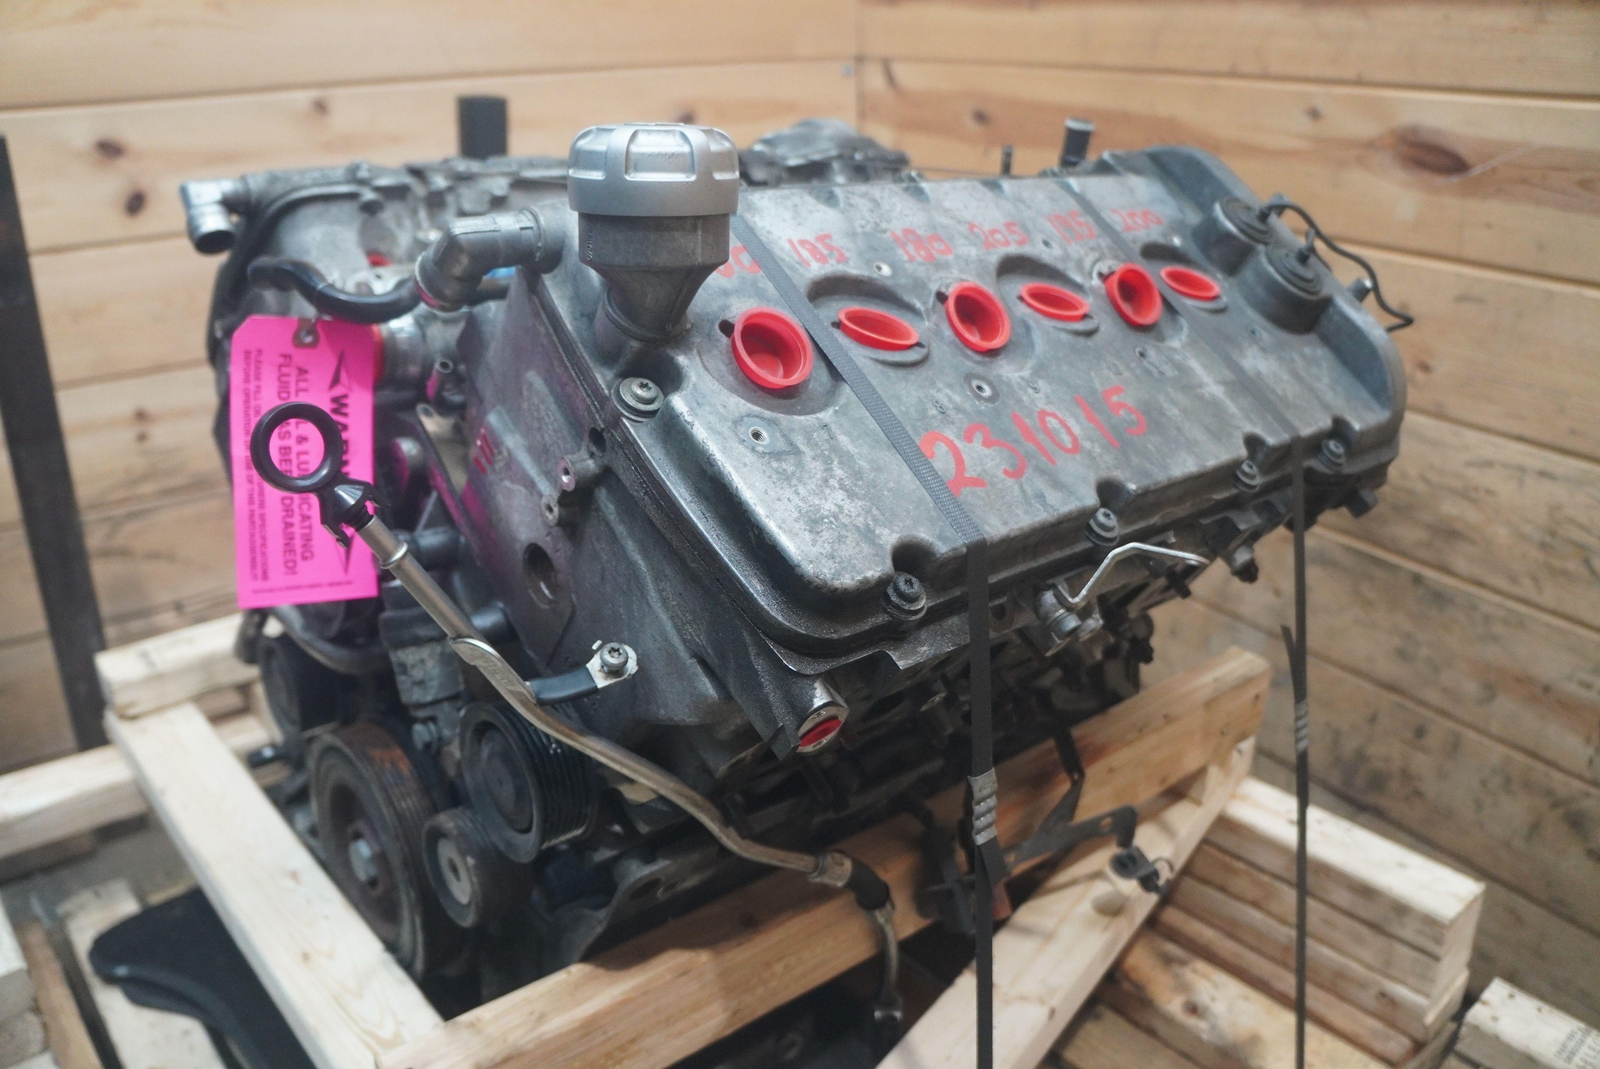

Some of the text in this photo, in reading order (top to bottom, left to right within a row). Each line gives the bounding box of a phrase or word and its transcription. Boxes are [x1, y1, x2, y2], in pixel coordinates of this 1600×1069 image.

[787, 233, 847, 268] 185
[890, 227, 954, 263] 180
[968, 221, 1029, 250] 205
[277, 354, 292, 401] FLUID
[296, 366, 309, 397] ALL
[933, 399, 947, 414] 8
[295, 435, 309, 445] &
[919, 384, 1148, 498] 231015
[296, 451, 314, 561] LUICATING
[280, 496, 298, 575] DRAINED!
